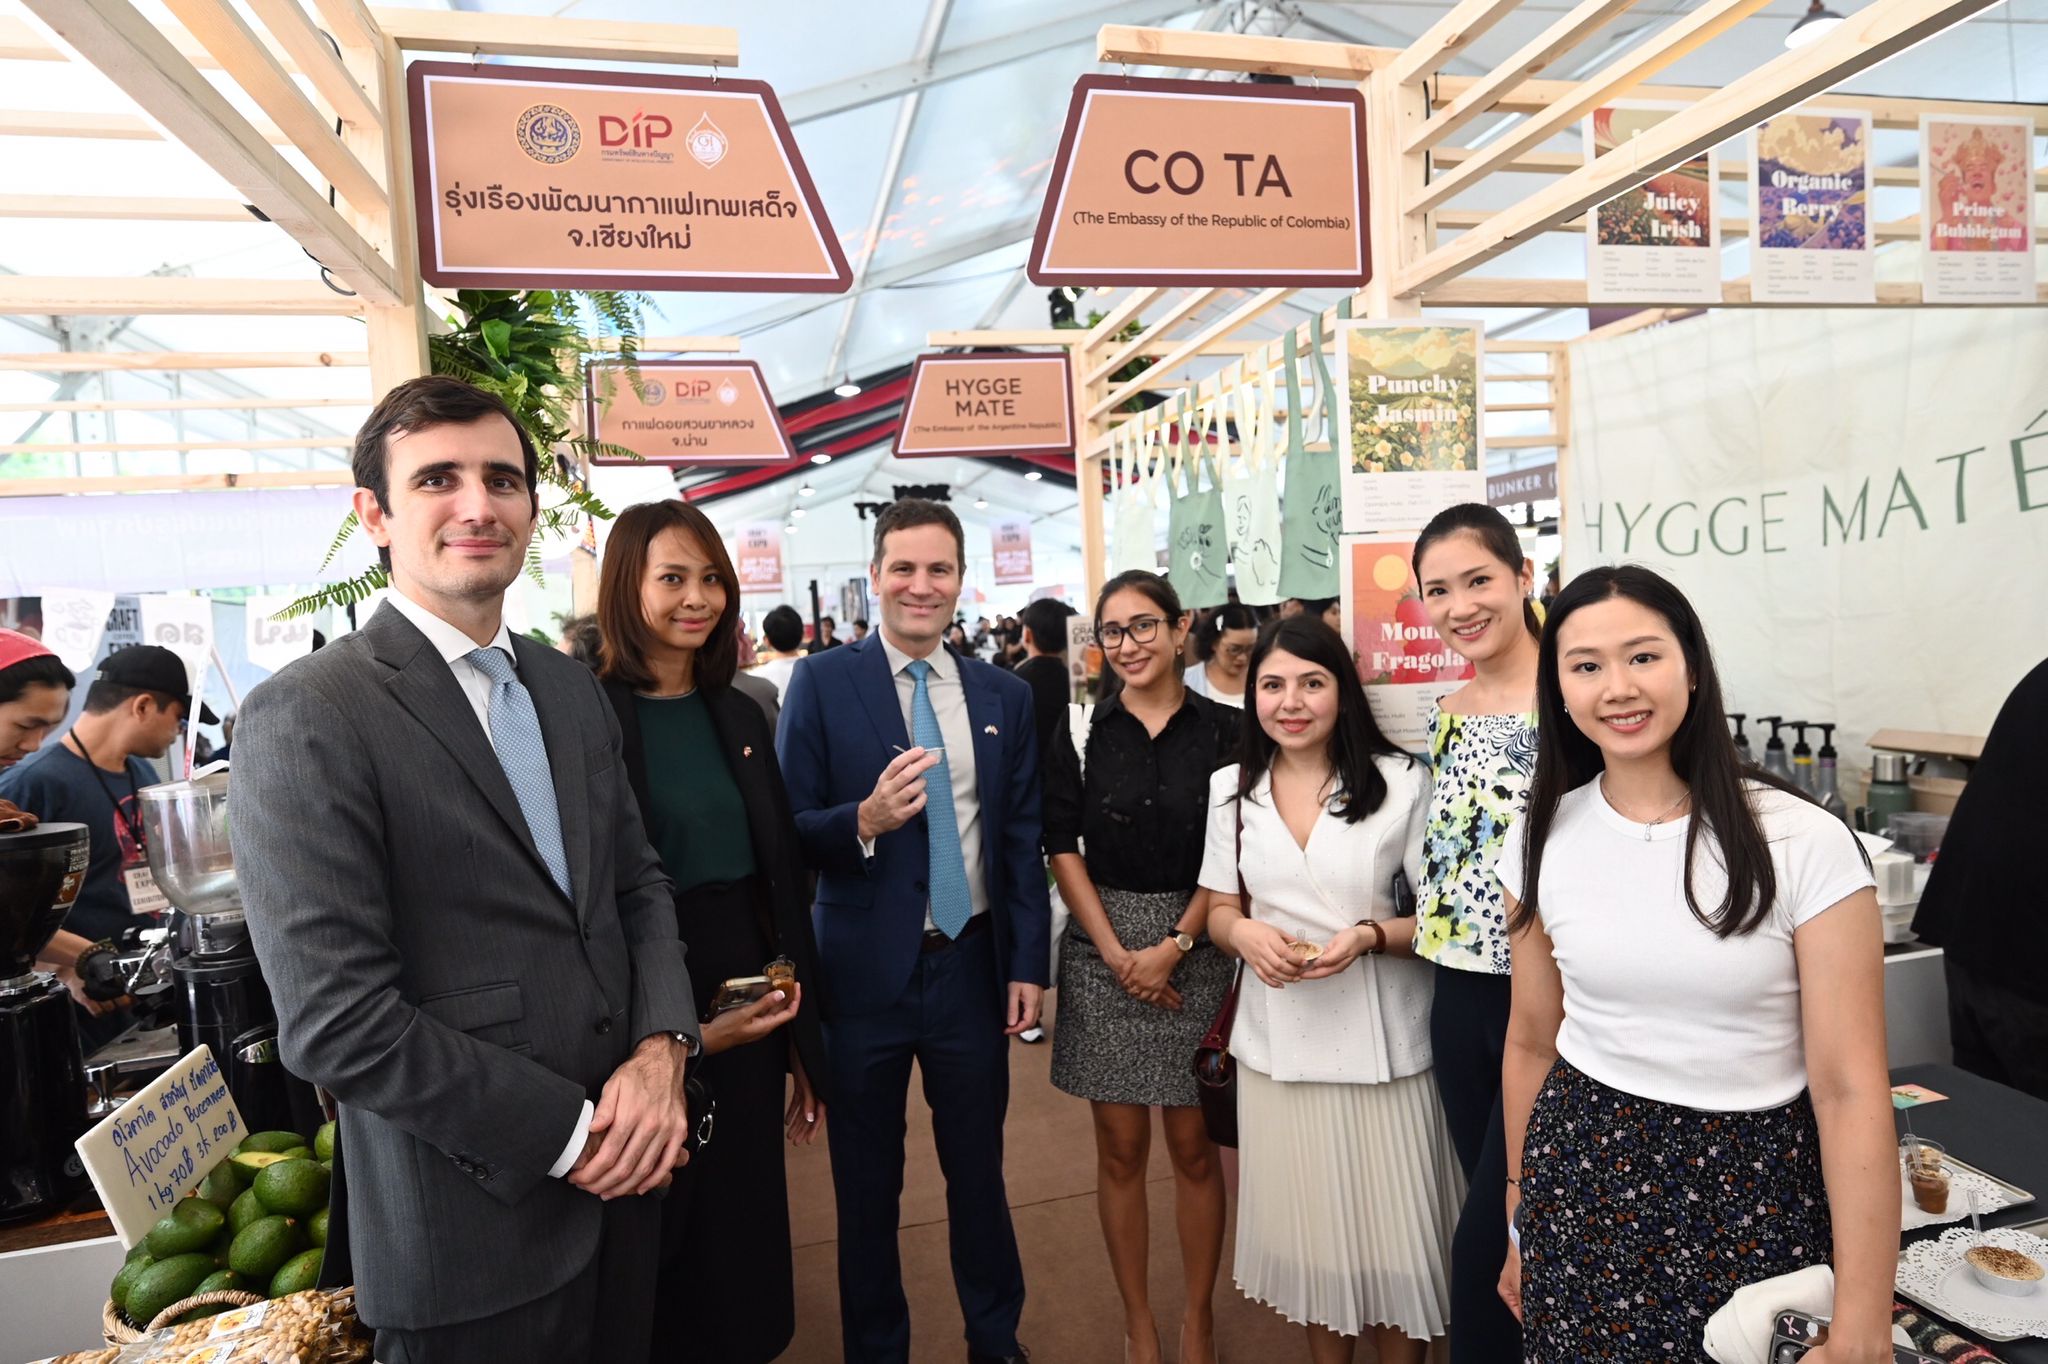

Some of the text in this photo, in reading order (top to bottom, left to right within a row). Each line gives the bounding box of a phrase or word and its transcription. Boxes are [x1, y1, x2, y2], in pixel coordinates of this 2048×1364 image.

[1124, 149, 1292, 198] CO TA
[1771, 170, 1853, 194] Organic
[444, 181, 797, 218] รุ่งเรืองพัฒนากาแฟเทพเสด็จ
[1643, 191, 1700, 215] Juicy
[1782, 197, 1842, 222] Berry
[1952, 202, 2005, 217] Prince
[1073, 211, 1350, 231] (The Embassy of the Republic of Colombia)
[1651, 219, 1701, 238] Irish
[567, 223, 692, 250] จ.เชียงใหม่
[1936, 223, 2022, 241] Bubblegum
[945, 378, 1022, 395] HYGGE
[1367, 374, 1462, 400] Punchy
[956, 400, 1015, 417] MATE
[1373, 403, 1459, 423] Jasmin
[622, 418, 755, 431] กาแฟดอยสวนยาหลวง
[913, 425, 930, 433] (The
[932, 425, 964, 433] Embassy
[967, 424, 975, 432] of
[992, 423, 1026, 431] Argentine
[672, 435, 708, 447] จ.น่าน
[1488, 474, 1542, 500] BUNKER
[1582, 491, 1788, 557] HYGGE
[1822, 410, 2048, 547] MATÉ
[1381, 622, 1442, 640] Mou
[1372, 649, 1465, 672] Fragola
[123, 1116, 184, 1187] Avocado
